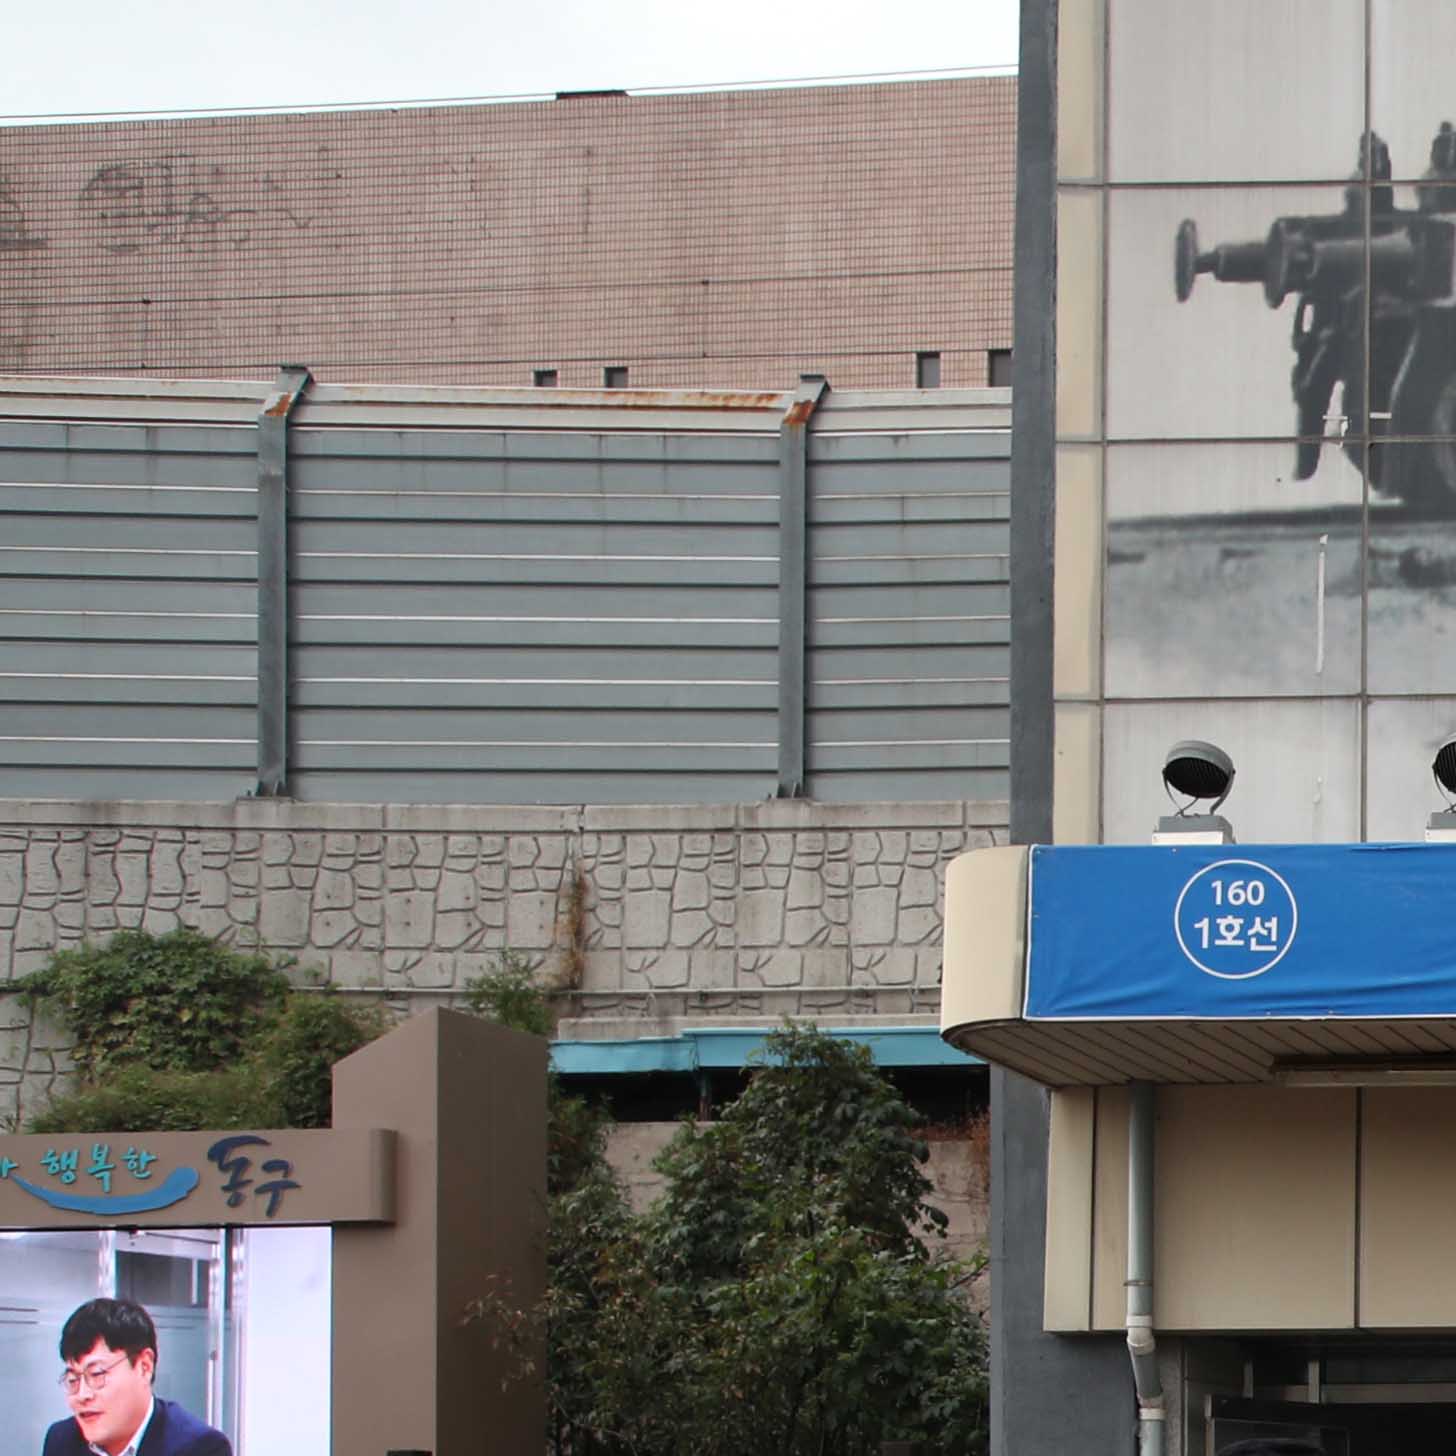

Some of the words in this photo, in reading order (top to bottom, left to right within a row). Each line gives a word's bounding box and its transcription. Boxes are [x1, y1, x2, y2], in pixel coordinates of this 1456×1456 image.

[1210, 880, 1265, 906] 160
[1193, 913, 1280, 951] 1호선
[40, 1144, 160, 1193] 행복한
[206, 1134, 301, 1217] 동구
